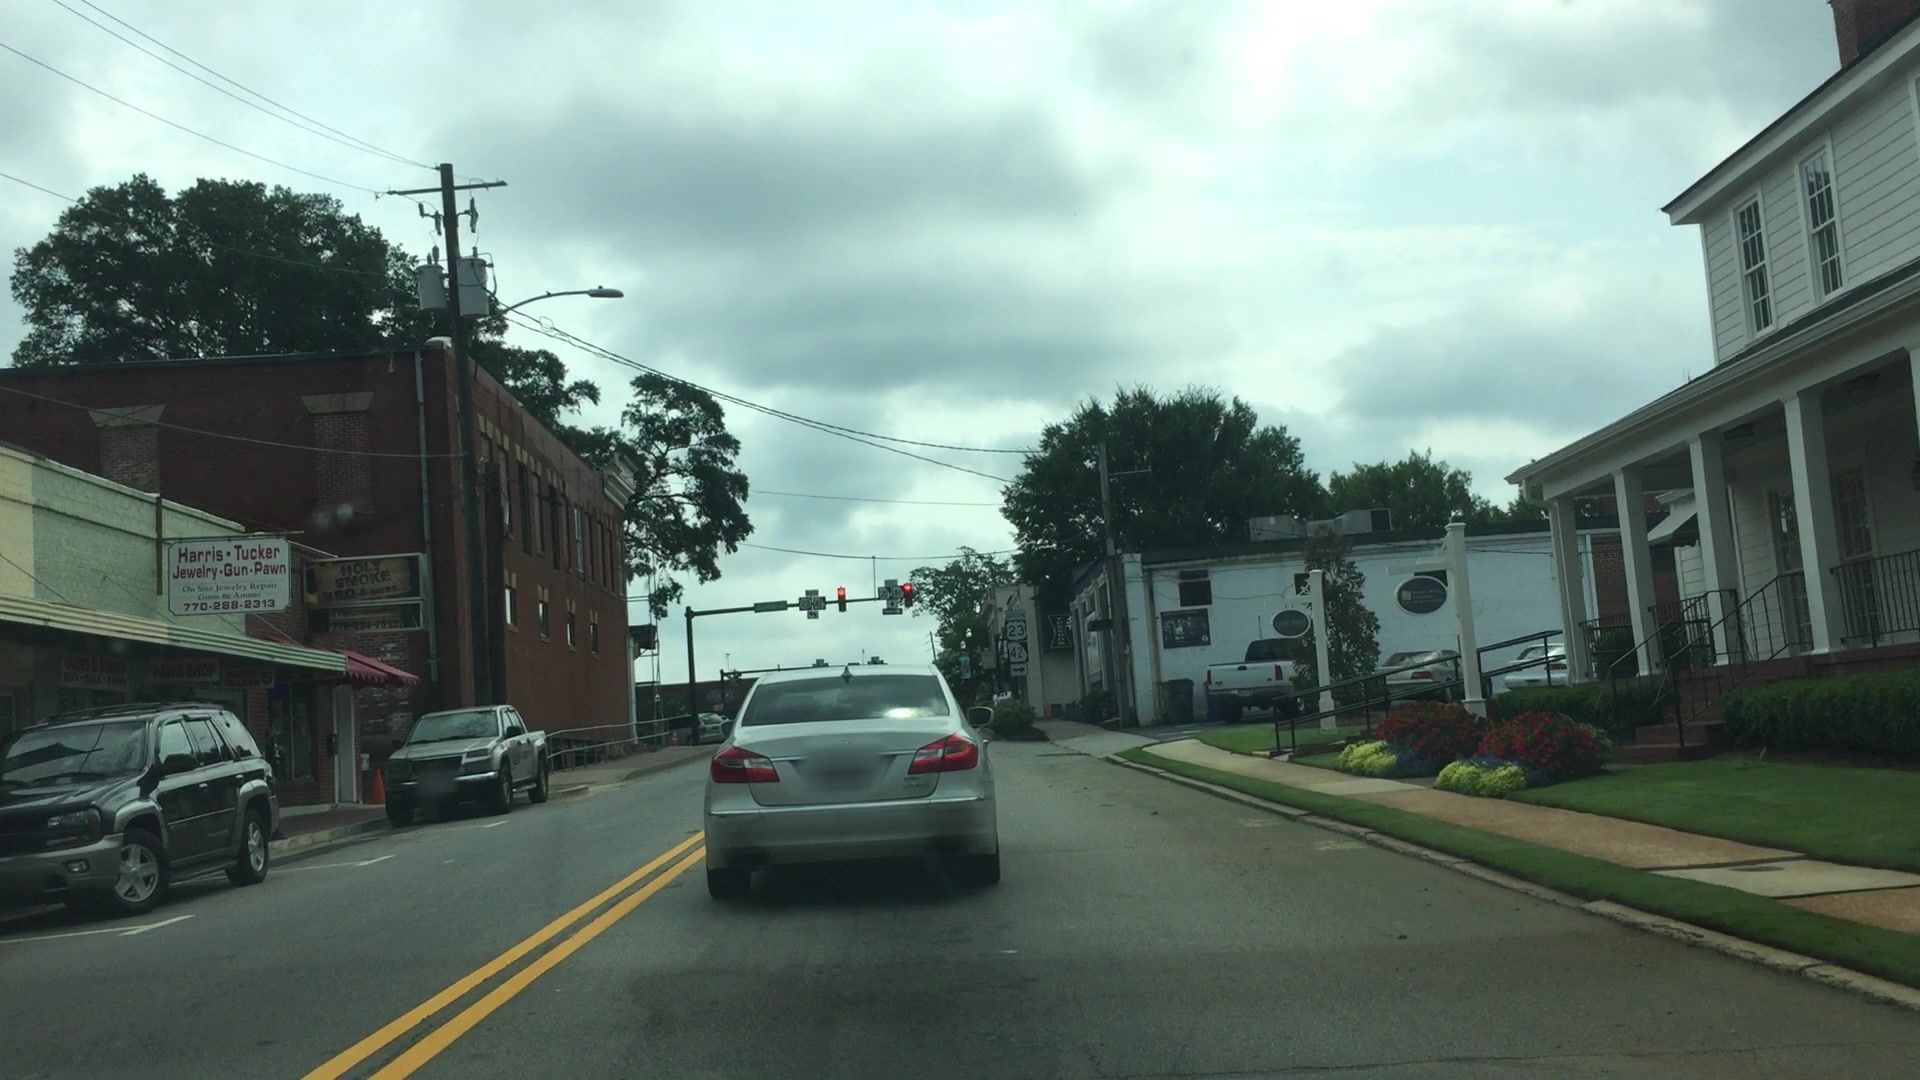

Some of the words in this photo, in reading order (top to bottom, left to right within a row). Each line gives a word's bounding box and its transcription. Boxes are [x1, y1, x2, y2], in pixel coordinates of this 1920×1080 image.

[178, 545, 223, 564] Harris
[233, 544, 280, 561] Tucker
[340, 559, 381, 576] HOLY
[215, 583, 247, 593] Jewelry
[250, 582, 277, 591] Repair
[183, 599, 276, 612] 770-288-2313
[1008, 624, 1025, 637] 23
[1010, 647, 1023, 658] 42
